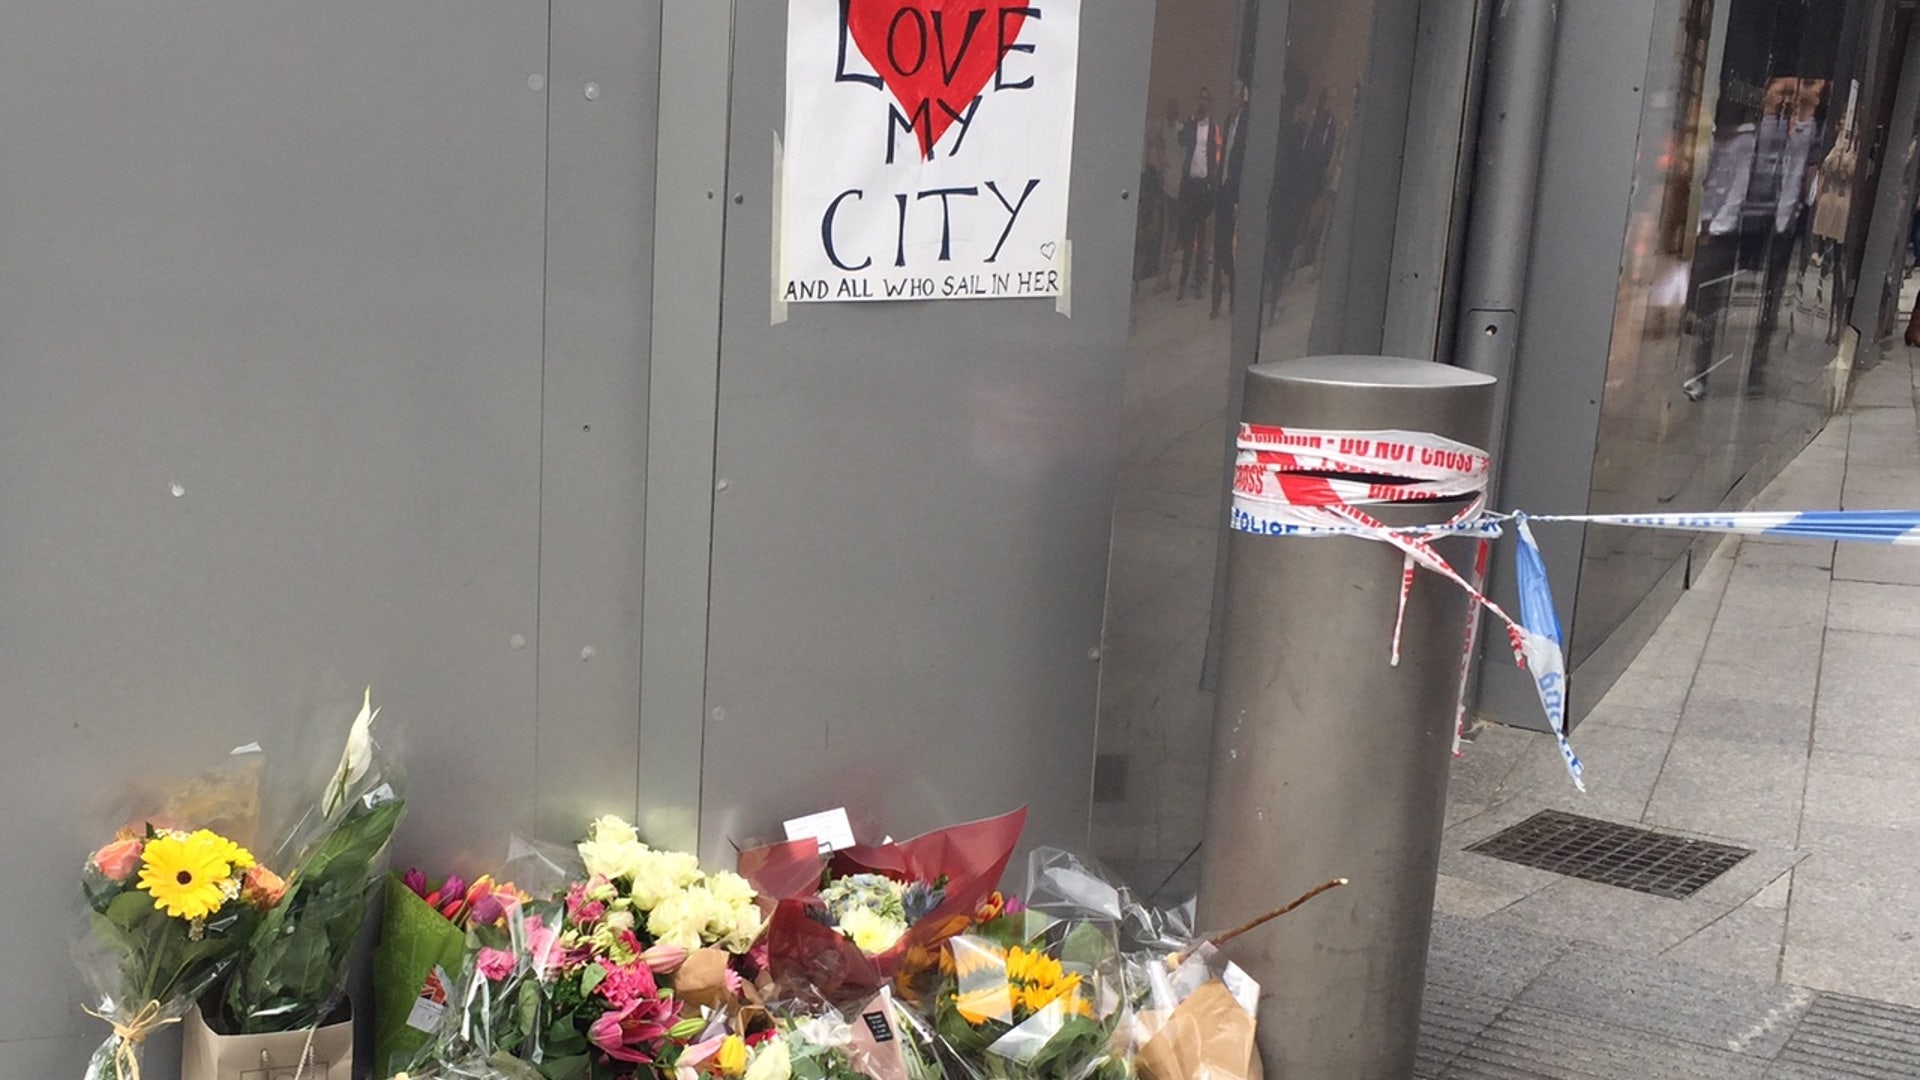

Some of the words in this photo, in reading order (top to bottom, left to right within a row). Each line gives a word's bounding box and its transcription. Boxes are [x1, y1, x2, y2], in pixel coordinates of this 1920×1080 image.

[835, 0, 1041, 91] LOVE
[885, 95, 983, 164] MY
[821, 179, 1041, 271] CITY
[784, 280, 829, 300] AND
[837, 278, 873, 298] ALL
[884, 278, 935, 297] WHO
[941, 276, 986, 295] SAIL
[992, 273, 1010, 294] IN
[1017, 270, 1059, 293] HER
